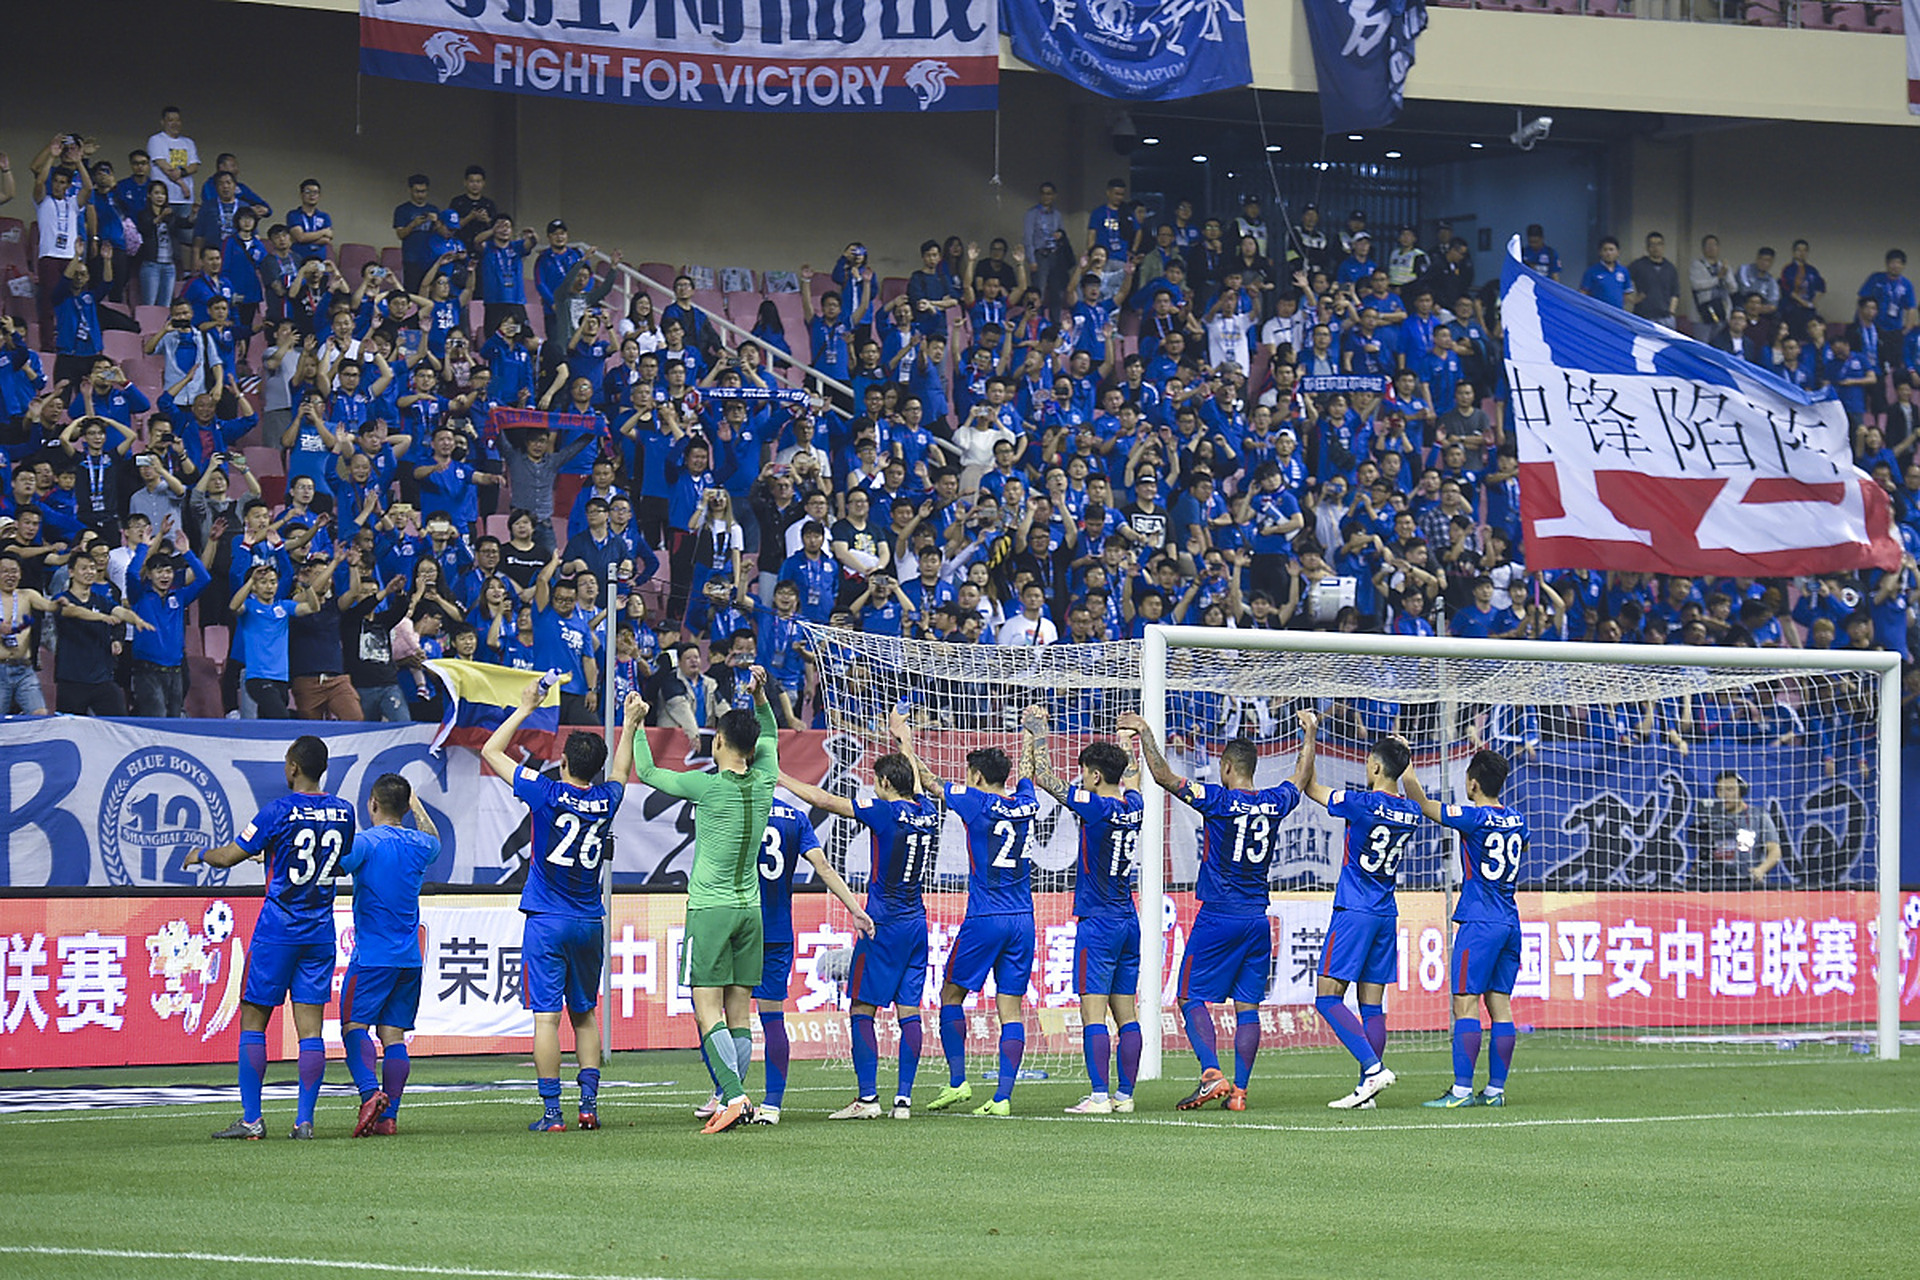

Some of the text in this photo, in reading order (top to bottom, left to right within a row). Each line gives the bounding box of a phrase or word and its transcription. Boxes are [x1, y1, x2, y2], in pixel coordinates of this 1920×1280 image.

[493, 43, 890, 106] FIGHT FOR VICTORY
[126, 754, 209, 787] BLUE BOYS
[122, 827, 181, 846] SHANGHAI
[127, 792, 201, 886] 12
[288, 828, 343, 886] 32
[546, 812, 603, 870] 26
[759, 826, 785, 881] 3
[903, 834, 931, 883] 11
[1232, 814, 1271, 864] 13
[1359, 824, 1411, 876] 36
[1480, 832, 1522, 882] 39
[0, 931, 127, 1033] 联赛
